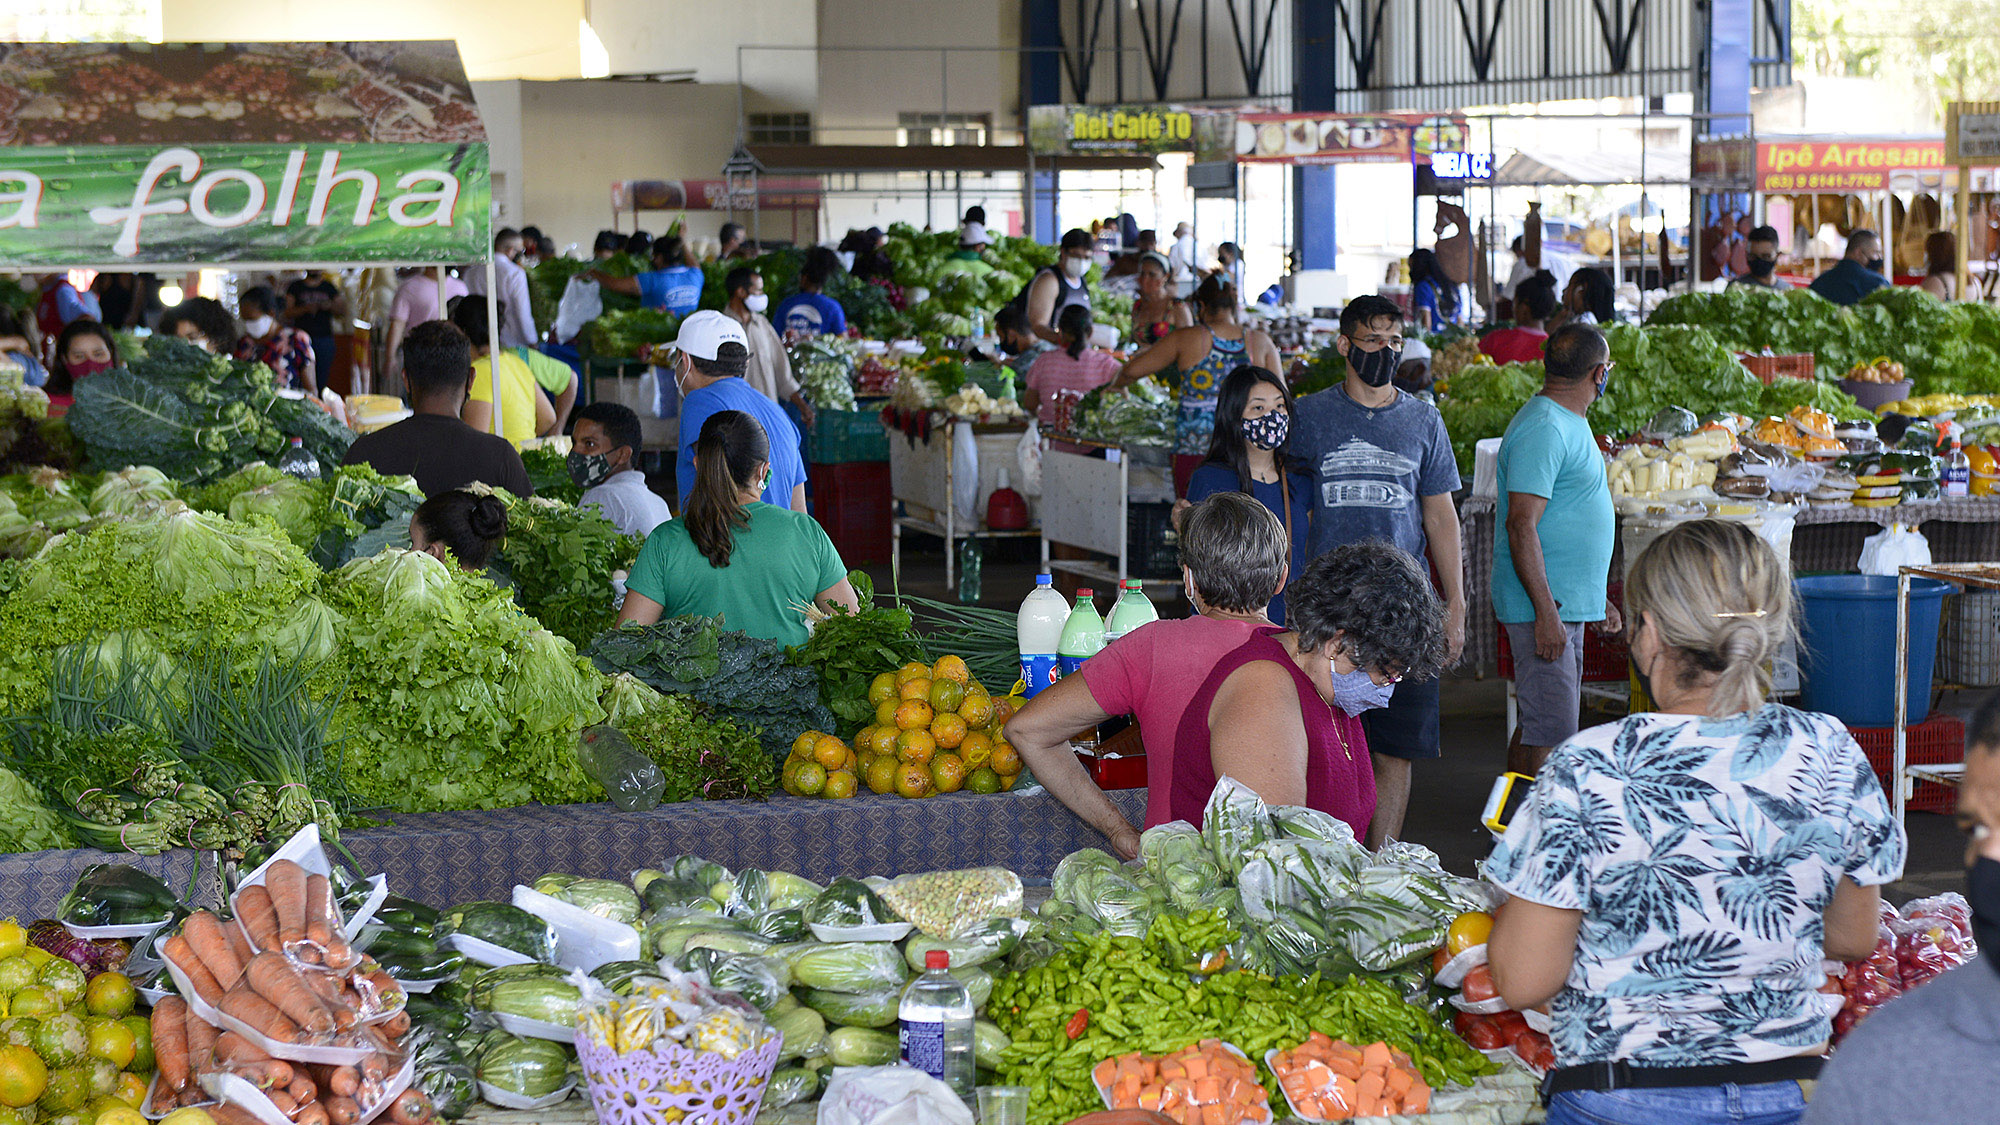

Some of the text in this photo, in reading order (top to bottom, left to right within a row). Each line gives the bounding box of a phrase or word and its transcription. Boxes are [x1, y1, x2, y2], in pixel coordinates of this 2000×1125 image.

[1073, 111, 1192, 140] Rei Café TO
[1768, 144, 1814, 172] Ipê
[1796, 174, 1807, 188] 9
[90, 147, 461, 259] folha
[1024, 665, 1034, 688] pepsi
